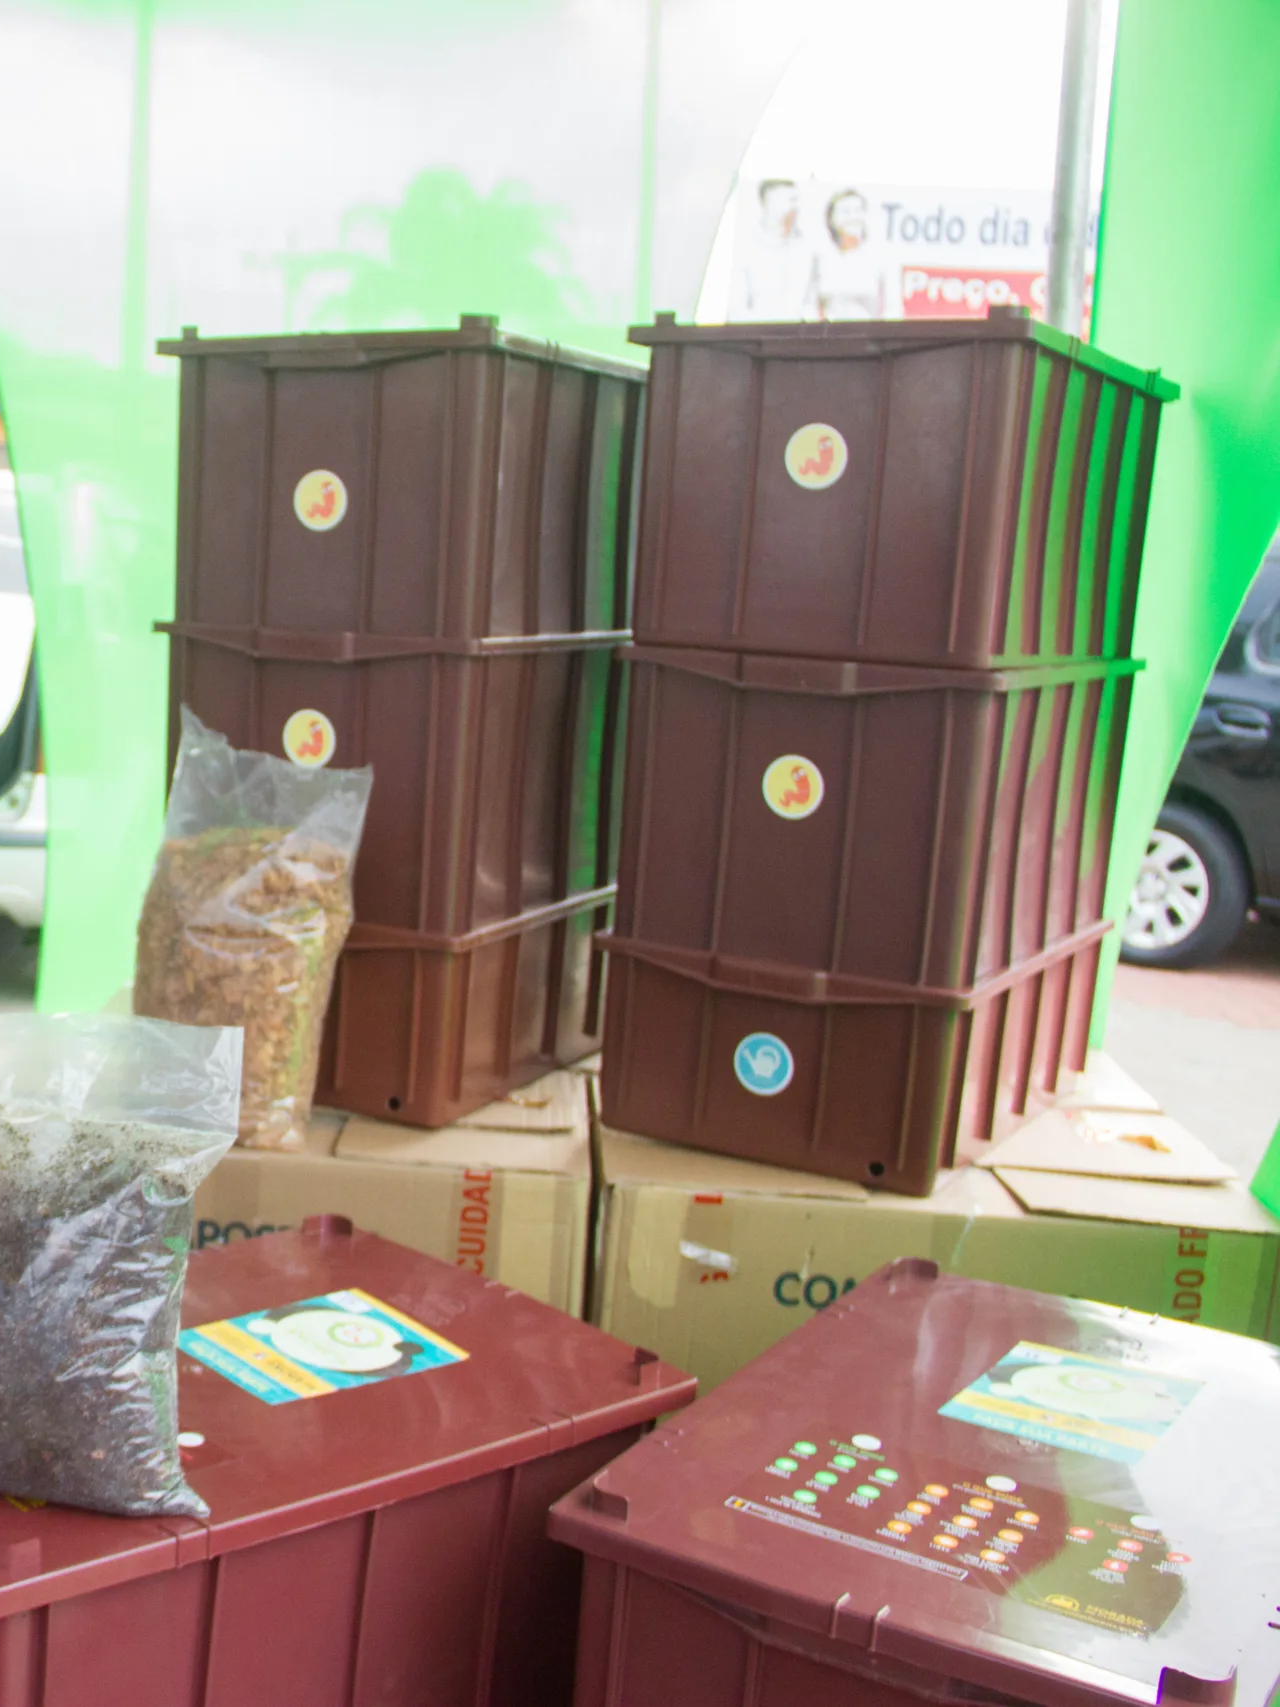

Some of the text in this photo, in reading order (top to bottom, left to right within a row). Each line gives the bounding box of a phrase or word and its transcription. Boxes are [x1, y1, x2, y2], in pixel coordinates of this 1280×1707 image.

[881, 202, 966, 244] Todo
[978, 206, 1031, 247] dia
[773, 1270, 857, 1310] CO
